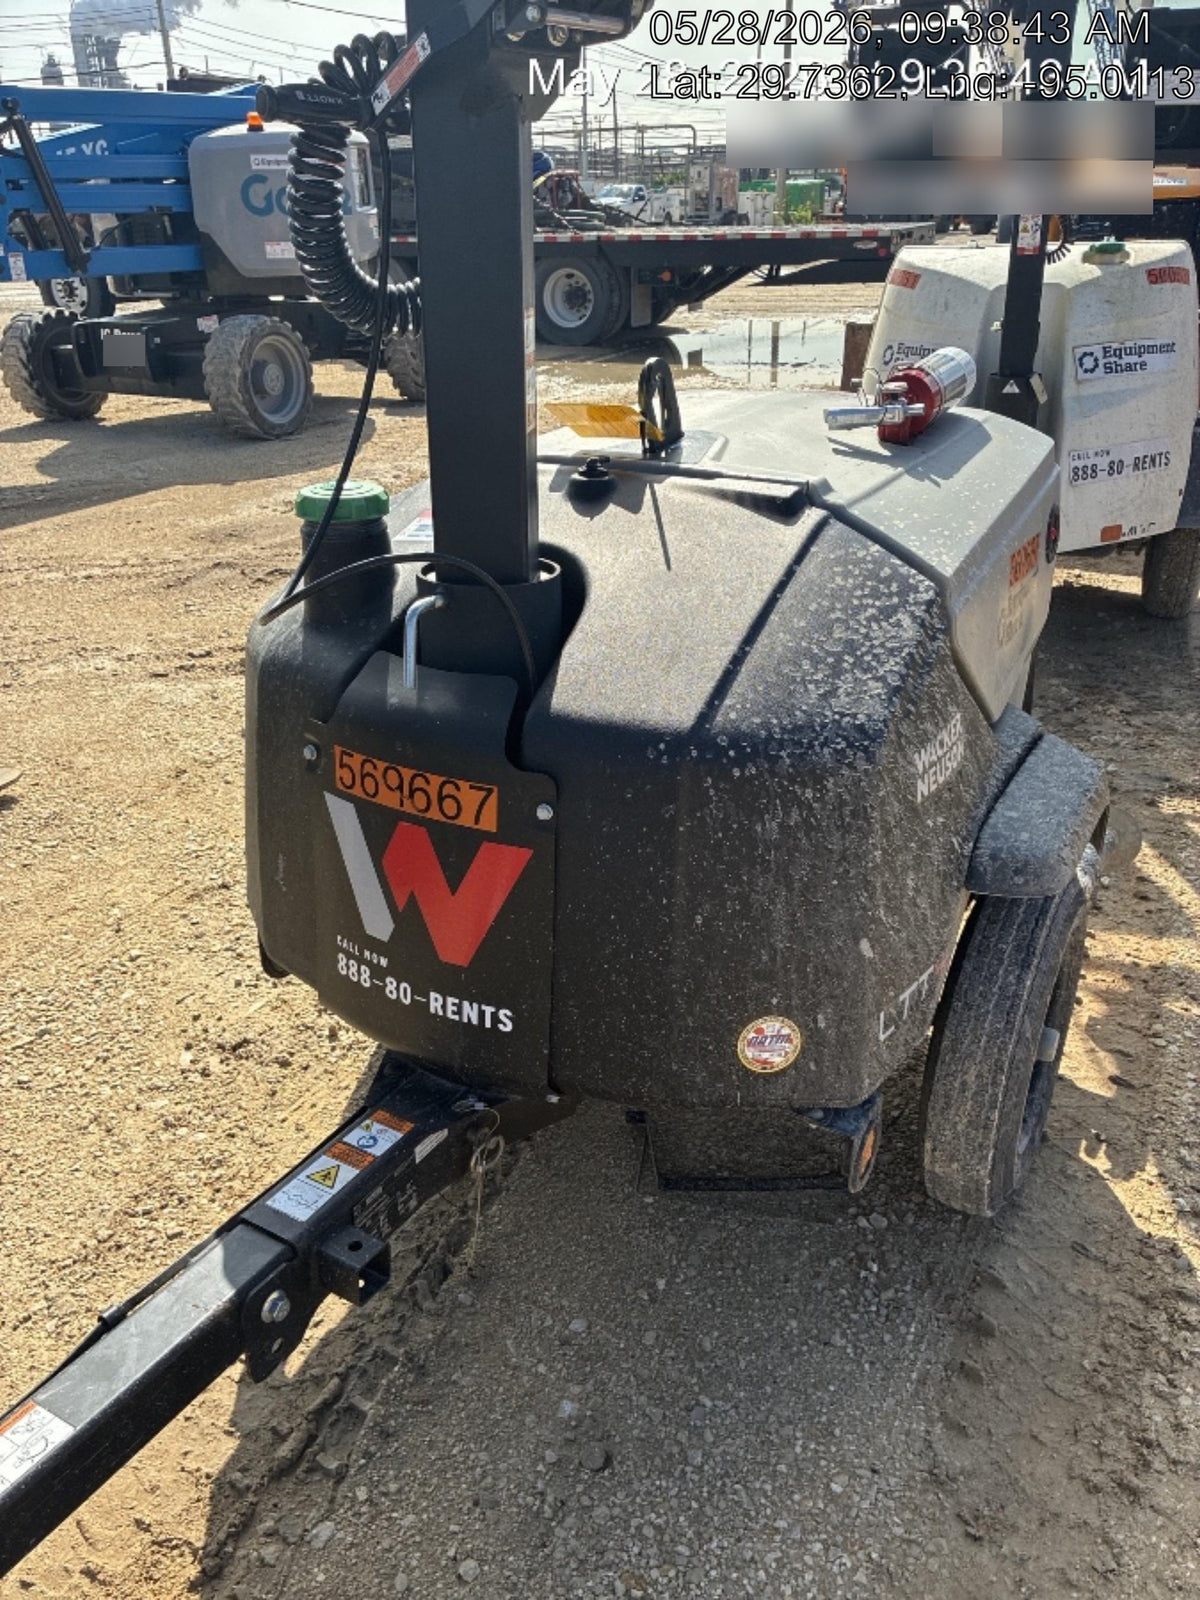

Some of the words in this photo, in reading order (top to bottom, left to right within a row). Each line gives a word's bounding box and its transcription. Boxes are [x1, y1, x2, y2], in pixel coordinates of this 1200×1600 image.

[1102, 342, 1176, 360] Equipment
[1103, 360, 1148, 374] Share
[1071, 451, 1171, 482] 888-80-RENTS
[338, 751, 494, 826] 569667
[336, 934, 360, 956] CALL
[363, 948, 389, 968] NOW
[336, 952, 514, 1033] 888-80-RENTS
